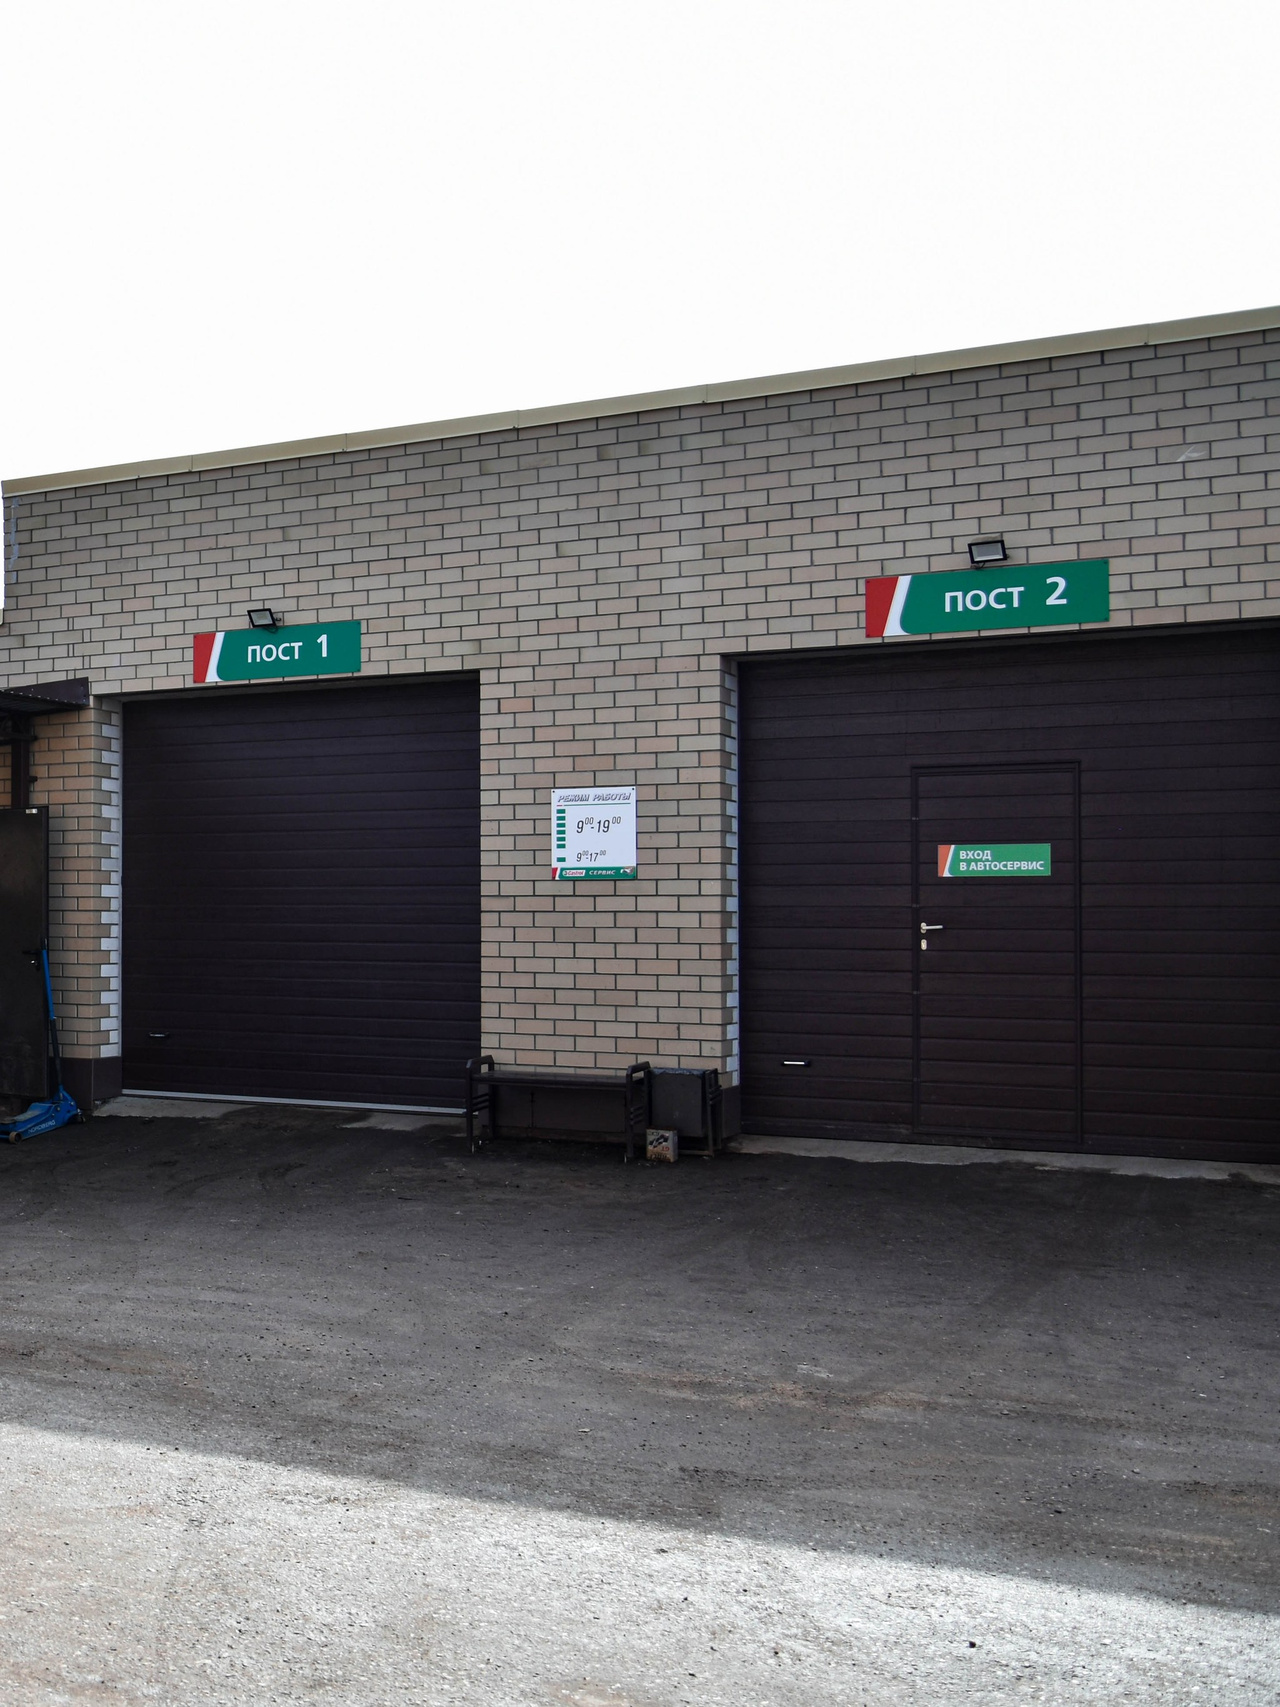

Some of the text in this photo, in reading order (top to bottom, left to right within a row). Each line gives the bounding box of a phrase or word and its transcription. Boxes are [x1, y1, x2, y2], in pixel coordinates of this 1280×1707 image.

[944, 576, 1068, 613] ПОСТ 2
[247, 634, 328, 663] ПОСТ 1
[557, 792, 632, 803] РЕЖИМ РАБОТЫ
[959, 850, 992, 860] ВХОД
[959, 861, 1045, 871] В АВТОСЕРВИС
